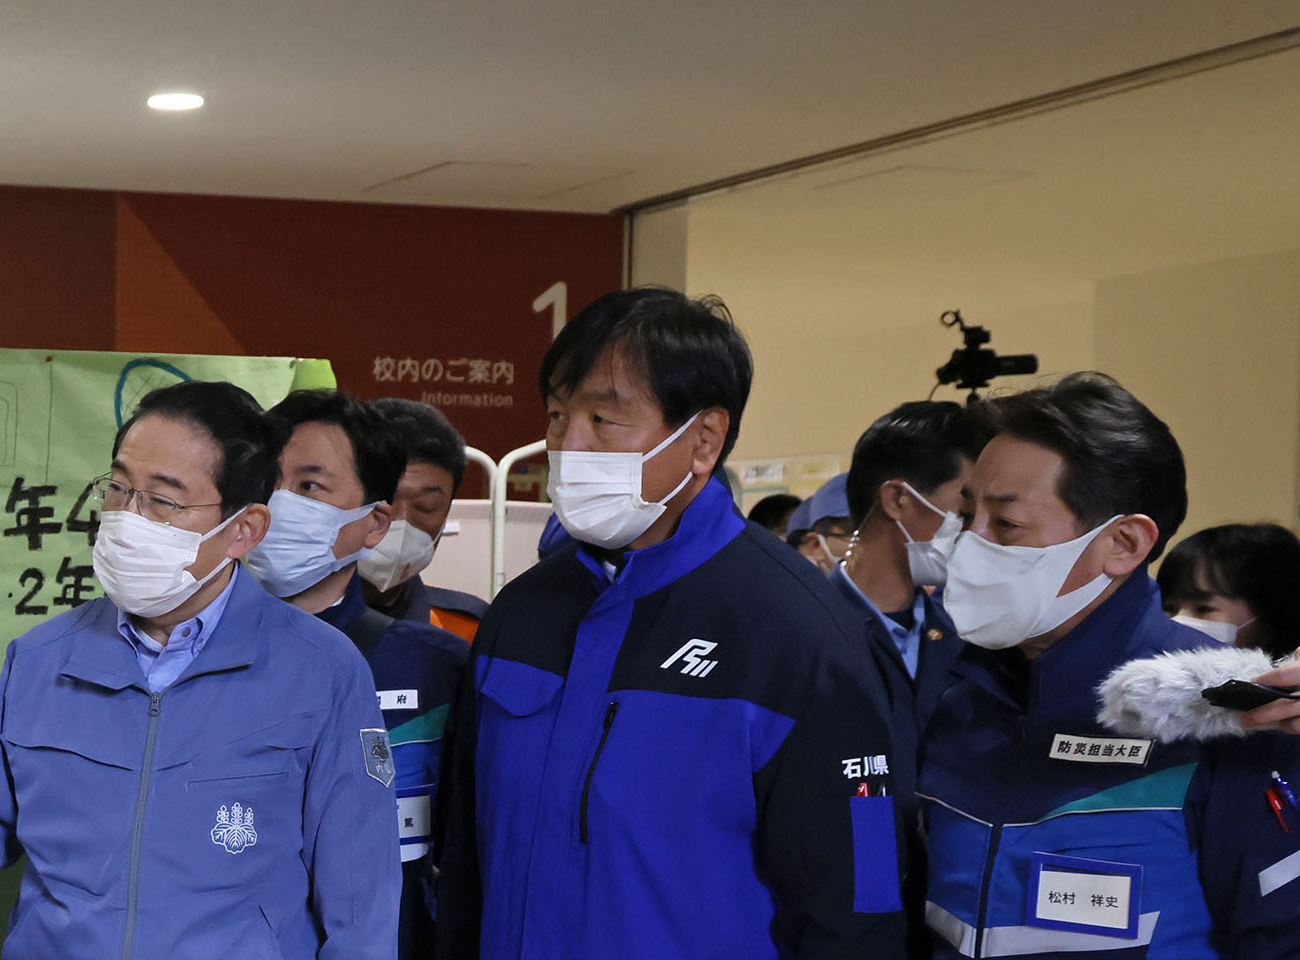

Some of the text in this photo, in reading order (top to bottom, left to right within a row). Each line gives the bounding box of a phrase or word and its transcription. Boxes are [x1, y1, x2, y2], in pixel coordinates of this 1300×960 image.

[372, 356, 514, 385] 校内のご案内
[1057, 741, 1142, 757] 防災担当大臣
[841, 754, 889, 779] 石川県
[1048, 891, 1118, 908] 松村 祥史
